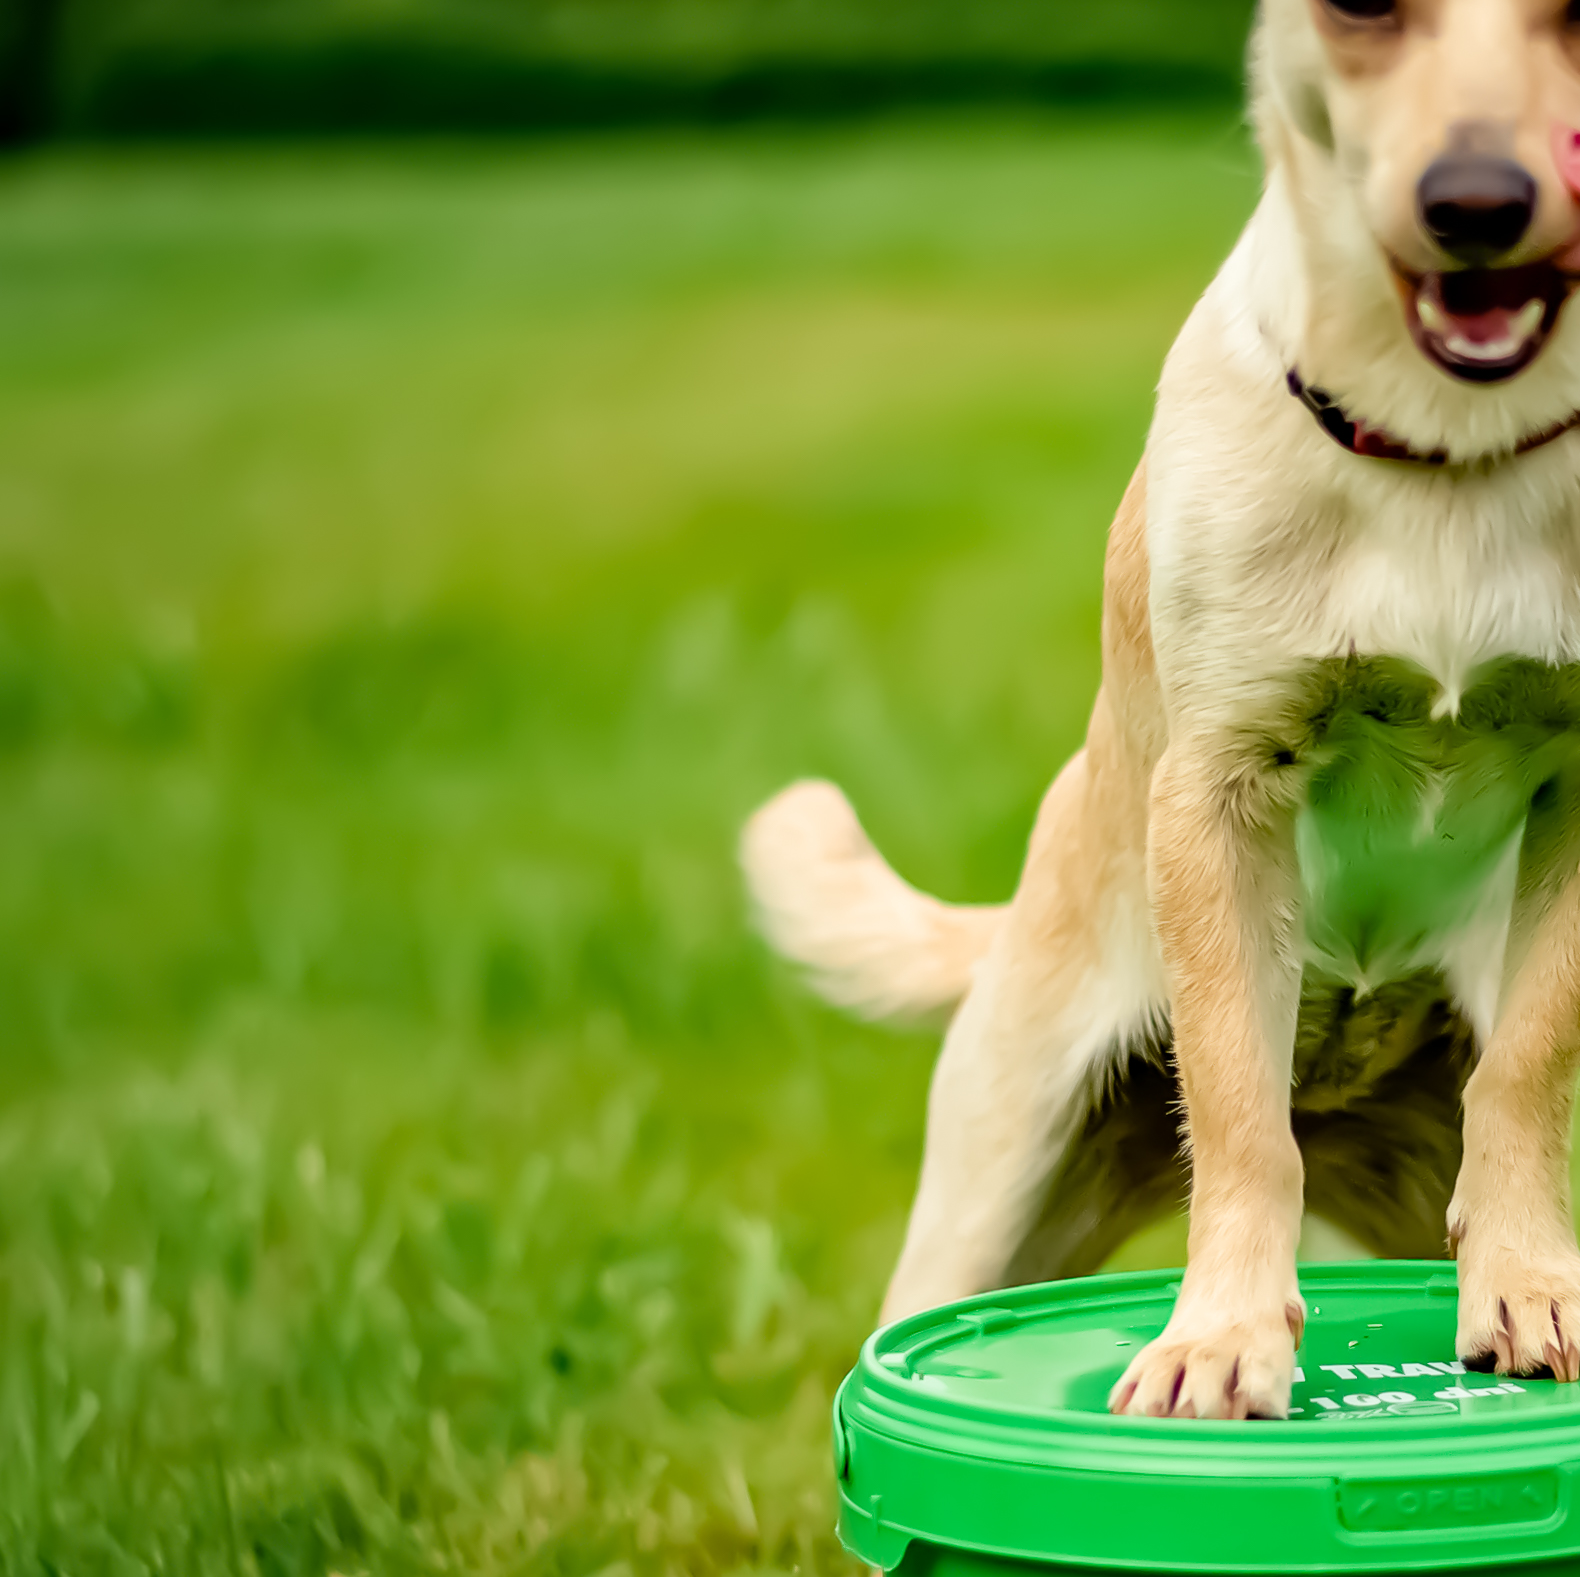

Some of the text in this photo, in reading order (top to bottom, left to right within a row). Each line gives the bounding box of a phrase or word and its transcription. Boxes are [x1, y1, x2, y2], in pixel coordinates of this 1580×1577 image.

[1309, 1390, 1417, 1411] 100
[1433, 1382, 1528, 1400] dni
[1396, 1486, 1503, 1515] OPEN
